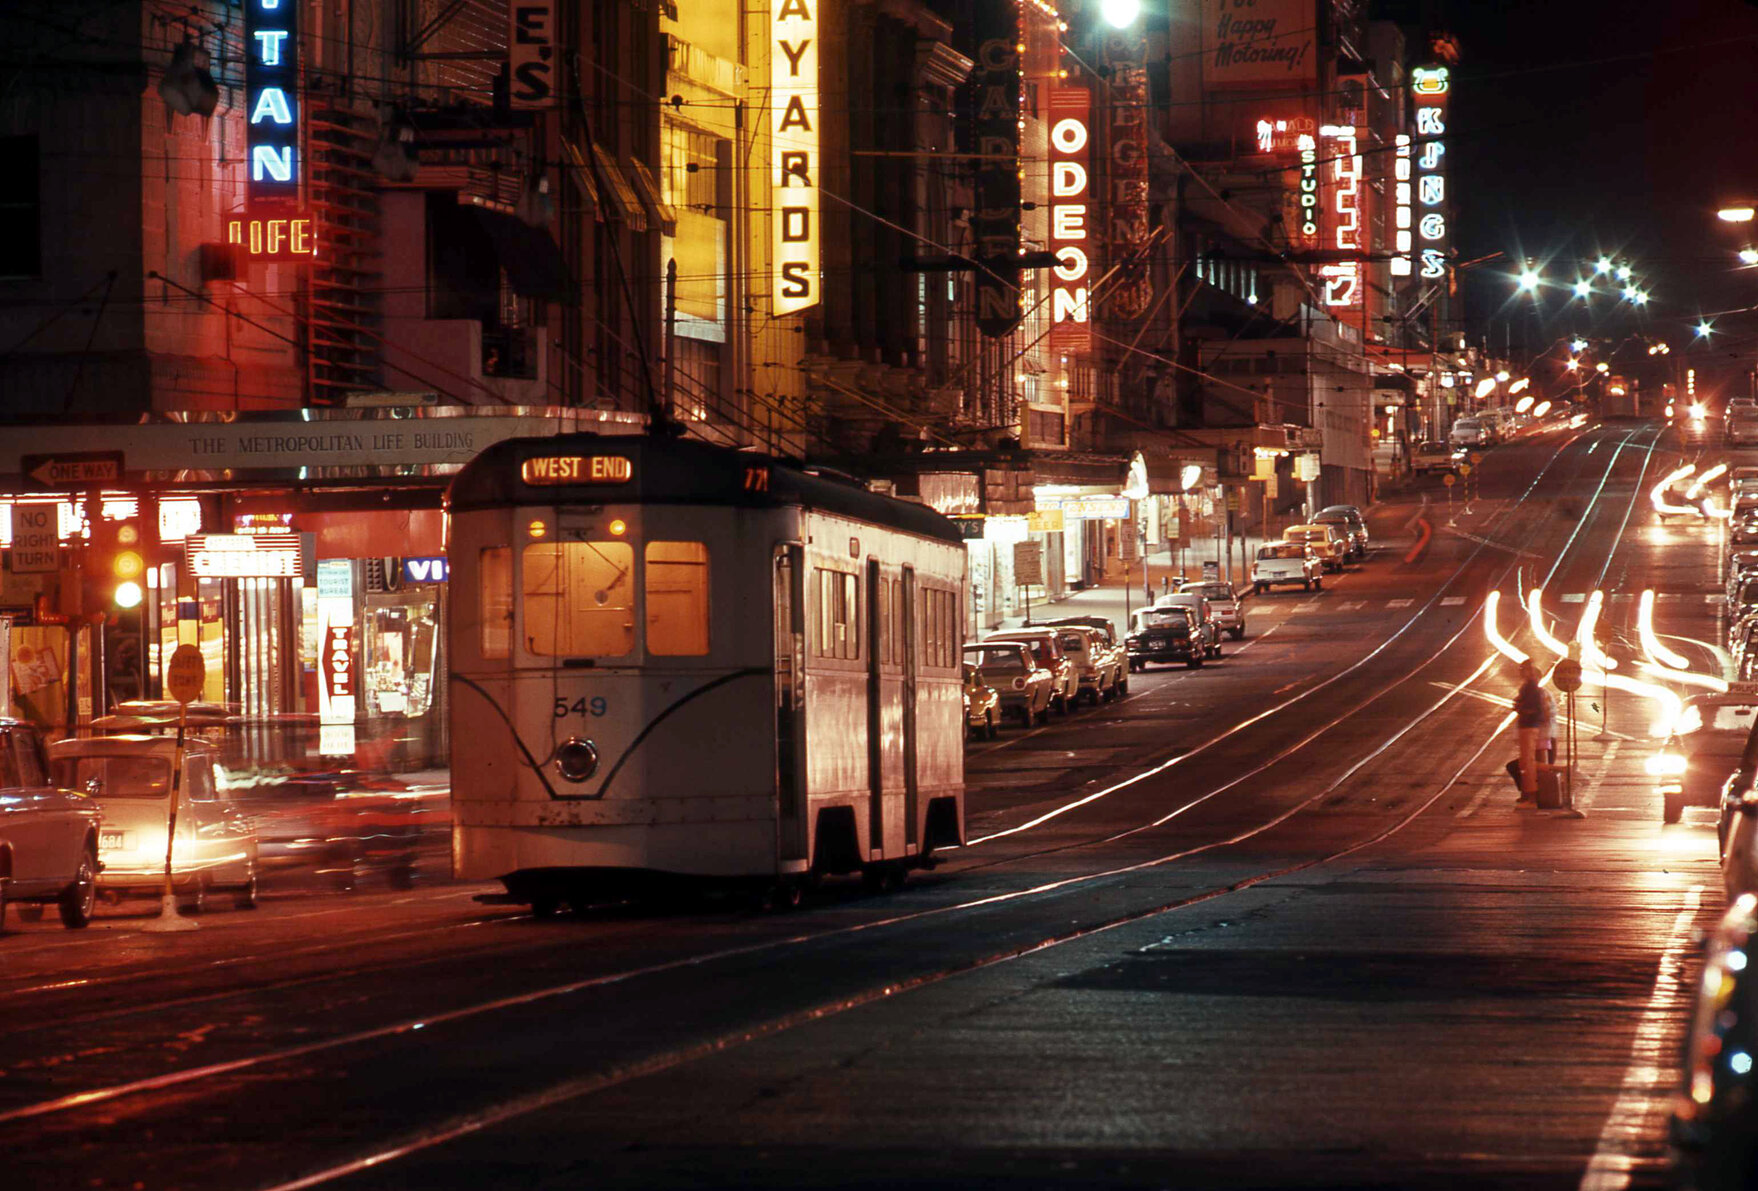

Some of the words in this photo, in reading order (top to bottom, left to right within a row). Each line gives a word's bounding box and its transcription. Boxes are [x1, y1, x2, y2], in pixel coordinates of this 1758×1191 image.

[1217, 13, 1277, 41] Happy
[1214, 40, 1311, 71] Motoring!
[251, 0, 293, 181] TAN
[1301, 150, 1317, 235] STUDIO
[1416, 106, 1446, 278] KINGS
[1051, 118, 1088, 324] ODEON
[189, 438, 226, 454] THE
[238, 434, 363, 453] METROPOLITAN
[373, 433, 404, 450] LIFE
[414, 432, 474, 449] BUILDING
[50, 464, 80, 479] ONE
[84, 463, 114, 477] WAY
[532, 457, 582, 477] WEST
[592, 456, 626, 478] END
[20, 512, 47, 528] NO
[15, 534, 55, 547] RIGHT
[17, 552, 54, 566] TURN
[408, 560, 449, 581] VI
[331, 627, 350, 694] TRAVEL
[555, 696, 606, 718] 549
